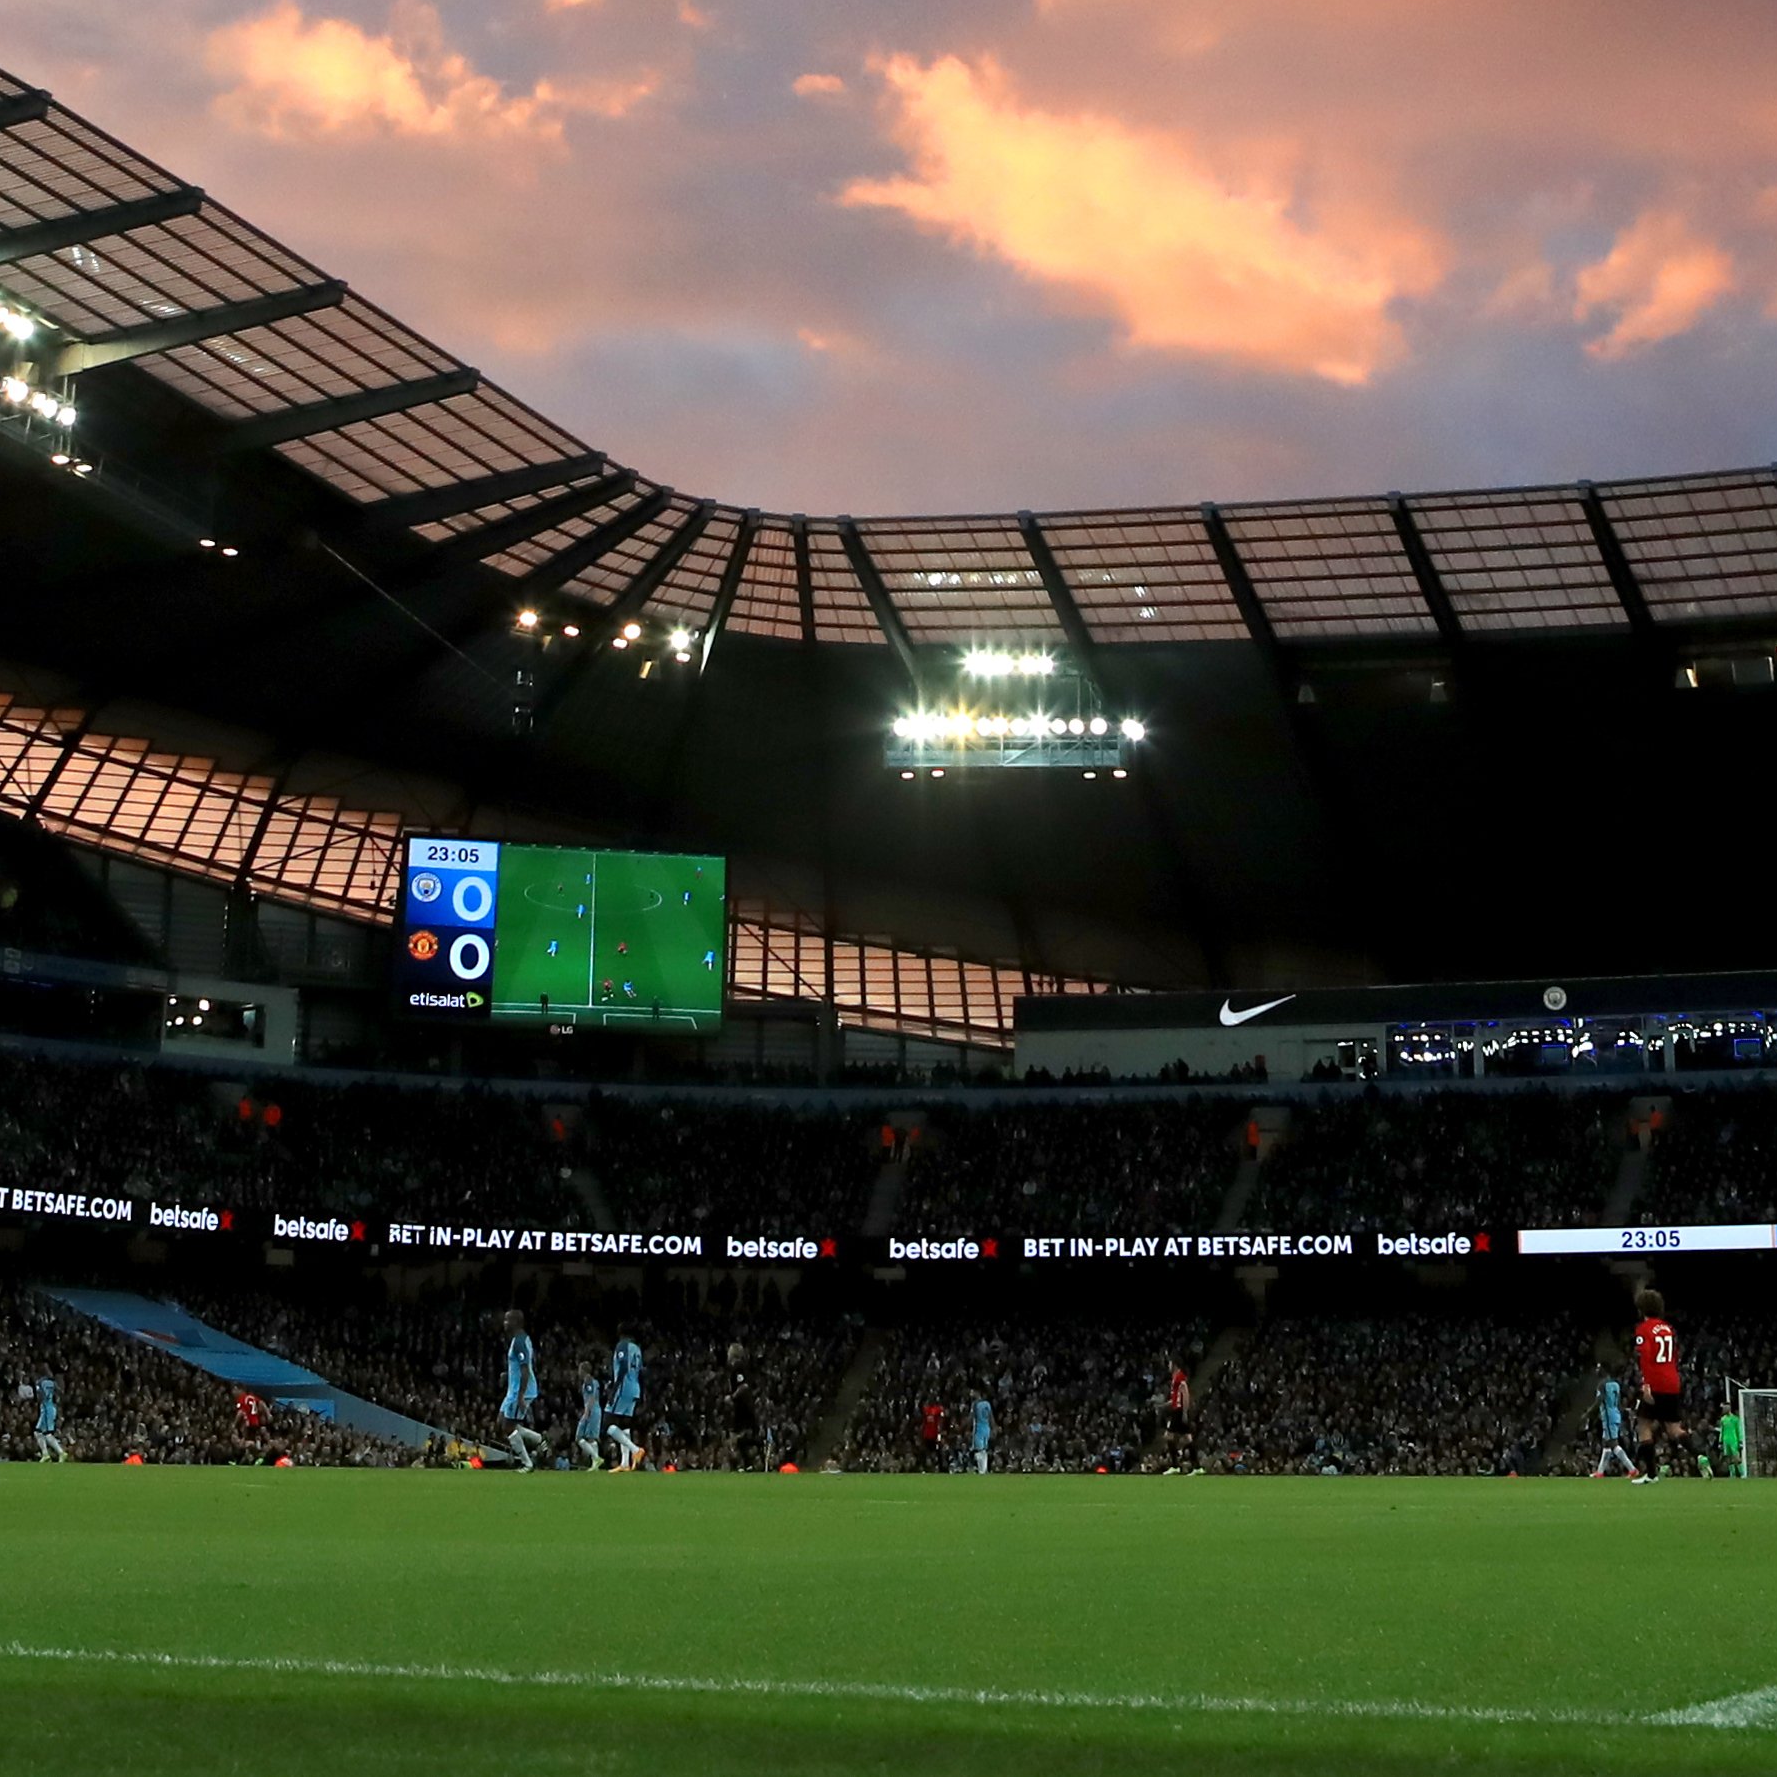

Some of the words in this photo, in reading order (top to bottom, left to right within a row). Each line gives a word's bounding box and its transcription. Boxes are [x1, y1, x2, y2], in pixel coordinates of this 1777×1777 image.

[428, 846, 479, 863] 23:05
[453, 876, 492, 922] 0
[449, 933, 490, 980] 0
[409, 992, 465, 1008] etisalat
[11, 1189, 132, 1222] BETSAFE.COM
[149, 1200, 219, 1231] betsafe
[273, 1214, 349, 1242] betsafe
[389, 1224, 426, 1245] BET
[429, 1225, 515, 1249] IN-PLAY
[517, 1230, 547, 1251] AT
[550, 1232, 702, 1256] BETSAFE.COM
[1621, 1230, 1681, 1248] 23:05
[726, 1235, 819, 1259] betsafe
[889, 1237, 980, 1260] betsafe
[1024, 1238, 1065, 1258] BET
[1070, 1237, 1160, 1257] IN-PLAY
[1163, 1237, 1193, 1256] AT
[1197, 1235, 1353, 1256] BETSAFE.COM
[1377, 1232, 1472, 1255] betsafe
[1655, 1335, 1673, 1363] 27
